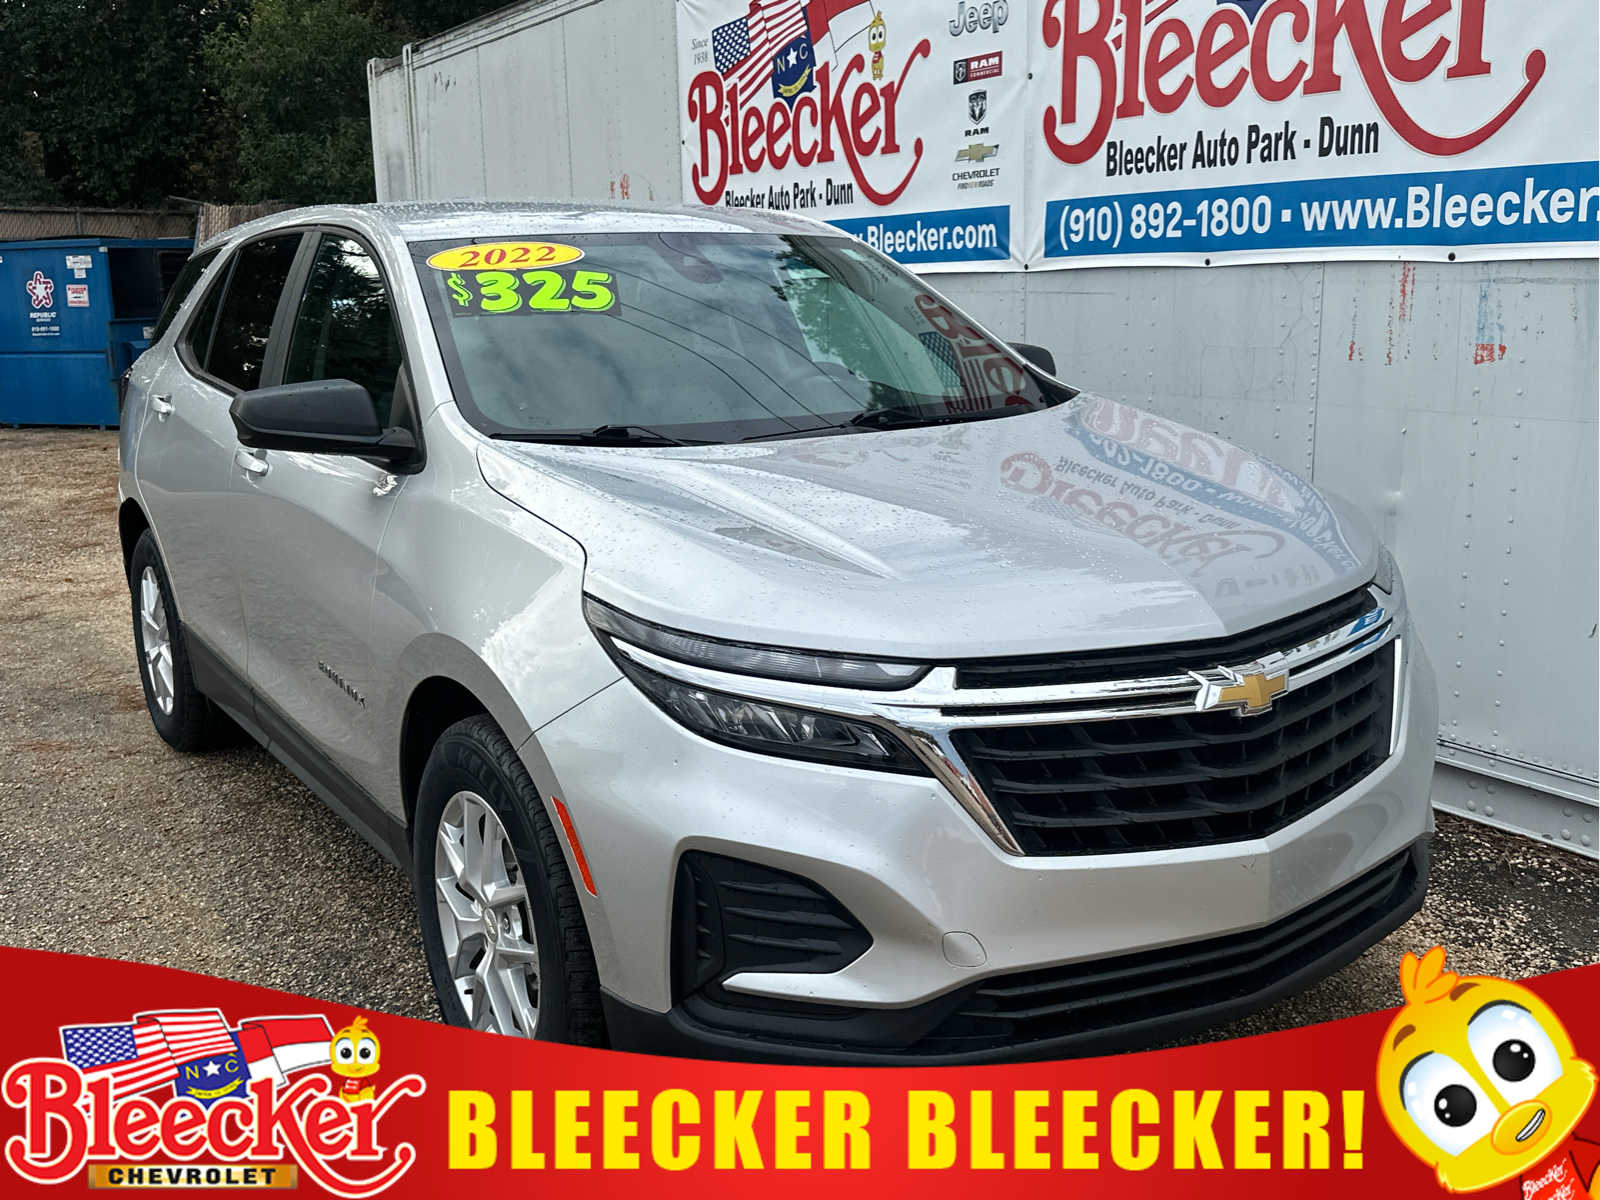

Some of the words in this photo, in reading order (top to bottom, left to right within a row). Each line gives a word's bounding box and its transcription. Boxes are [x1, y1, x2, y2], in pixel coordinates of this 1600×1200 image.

[948, 0, 1009, 37] Jeep
[776, 55, 786, 75] N
[799, 43, 809, 60] C
[970, 56, 1000, 70] RAM
[1042, 0, 1546, 164] Bleecker
[688, 38, 932, 206] Bleecker
[964, 126, 990, 137] RAM
[1105, 136, 1188, 177] Bleecker
[1191, 129, 1240, 169] Auto
[1246, 120, 1297, 164] Park
[1317, 115, 1379, 158] Dunn
[952, 167, 1001, 182] CHEVROLET
[767, 184, 790, 211] Auto
[793, 179, 817, 209] Park
[825, 178, 854, 206] Dunn
[1059, 201, 1123, 250] (910)
[1130, 195, 1272, 240] 892-1800
[458, 245, 556, 268] 2022
[447, 270, 615, 313] $325
